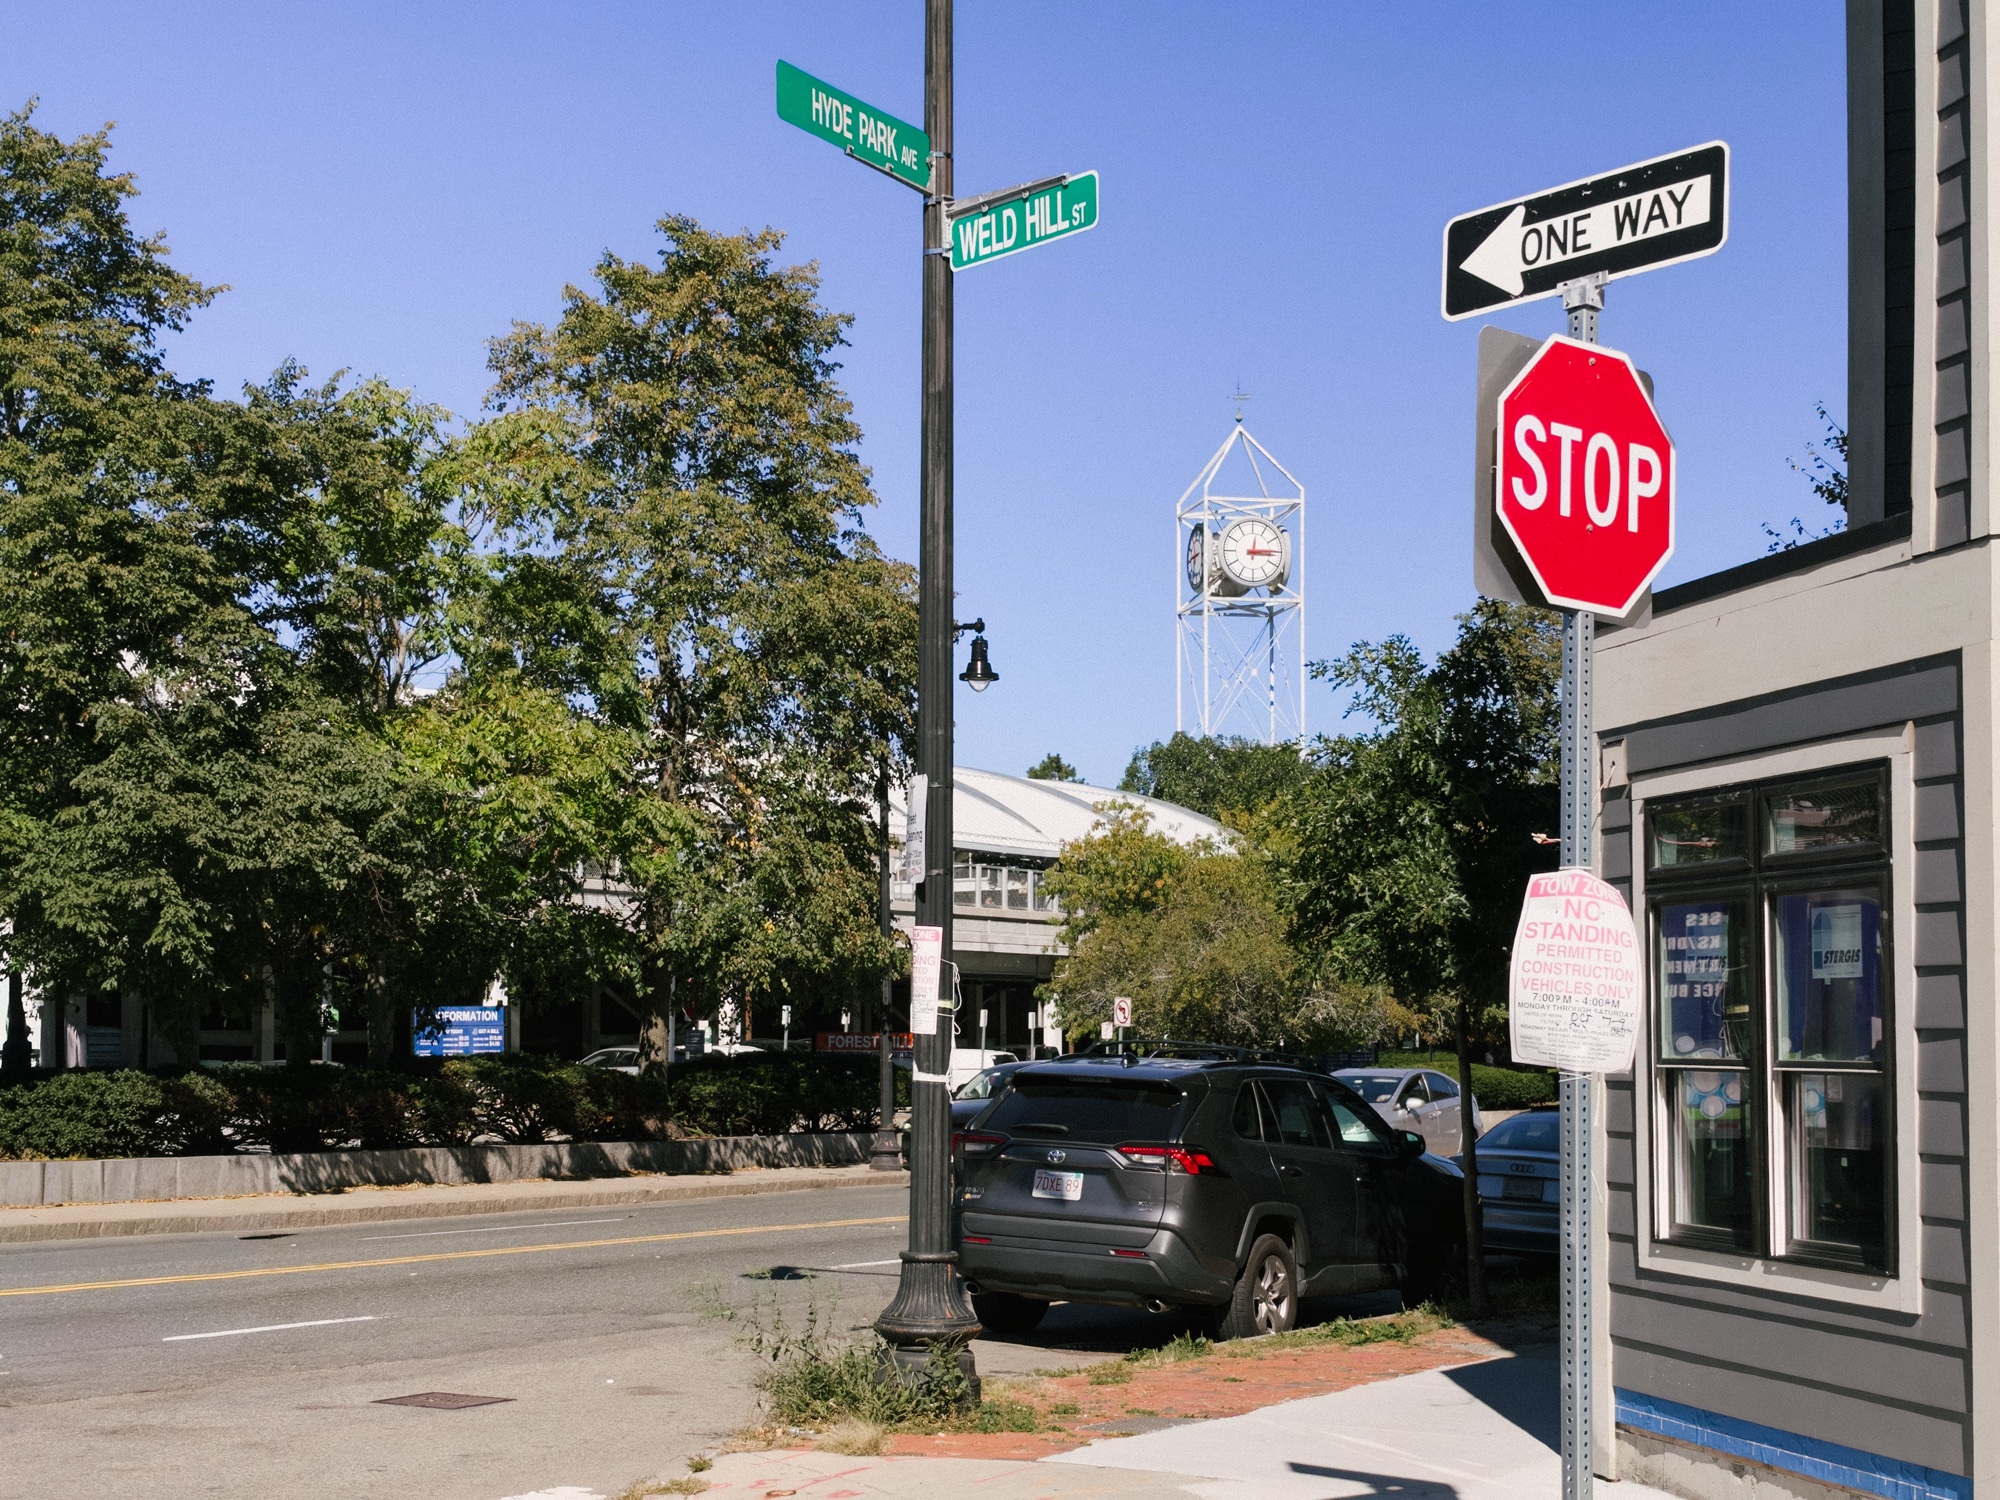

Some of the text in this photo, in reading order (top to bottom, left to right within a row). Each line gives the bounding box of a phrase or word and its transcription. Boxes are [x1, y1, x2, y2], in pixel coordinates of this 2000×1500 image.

[811, 88, 918, 171] HYDE PARK AVE
[959, 191, 1087, 262] WELD HILL ST
[1521, 184, 1694, 266] ONE WAY
[1512, 414, 1662, 533] STOP
[1538, 876, 1623, 906] TOW ZONE
[1524, 921, 1633, 948] STANDING
[1536, 943, 1622, 964] PERMITTED
[1823, 949, 1861, 965] STERGIS
[1522, 960, 1634, 982] CONSTRUCTION
[1521, 977, 1633, 1000] VEHICLES ONLY
[1517, 1001, 1635, 1019] MONDAY THROUGH SATURDAY
[828, 1035, 880, 1048] FOREST
[1035, 1176, 1079, 1192] 7DXE 89
